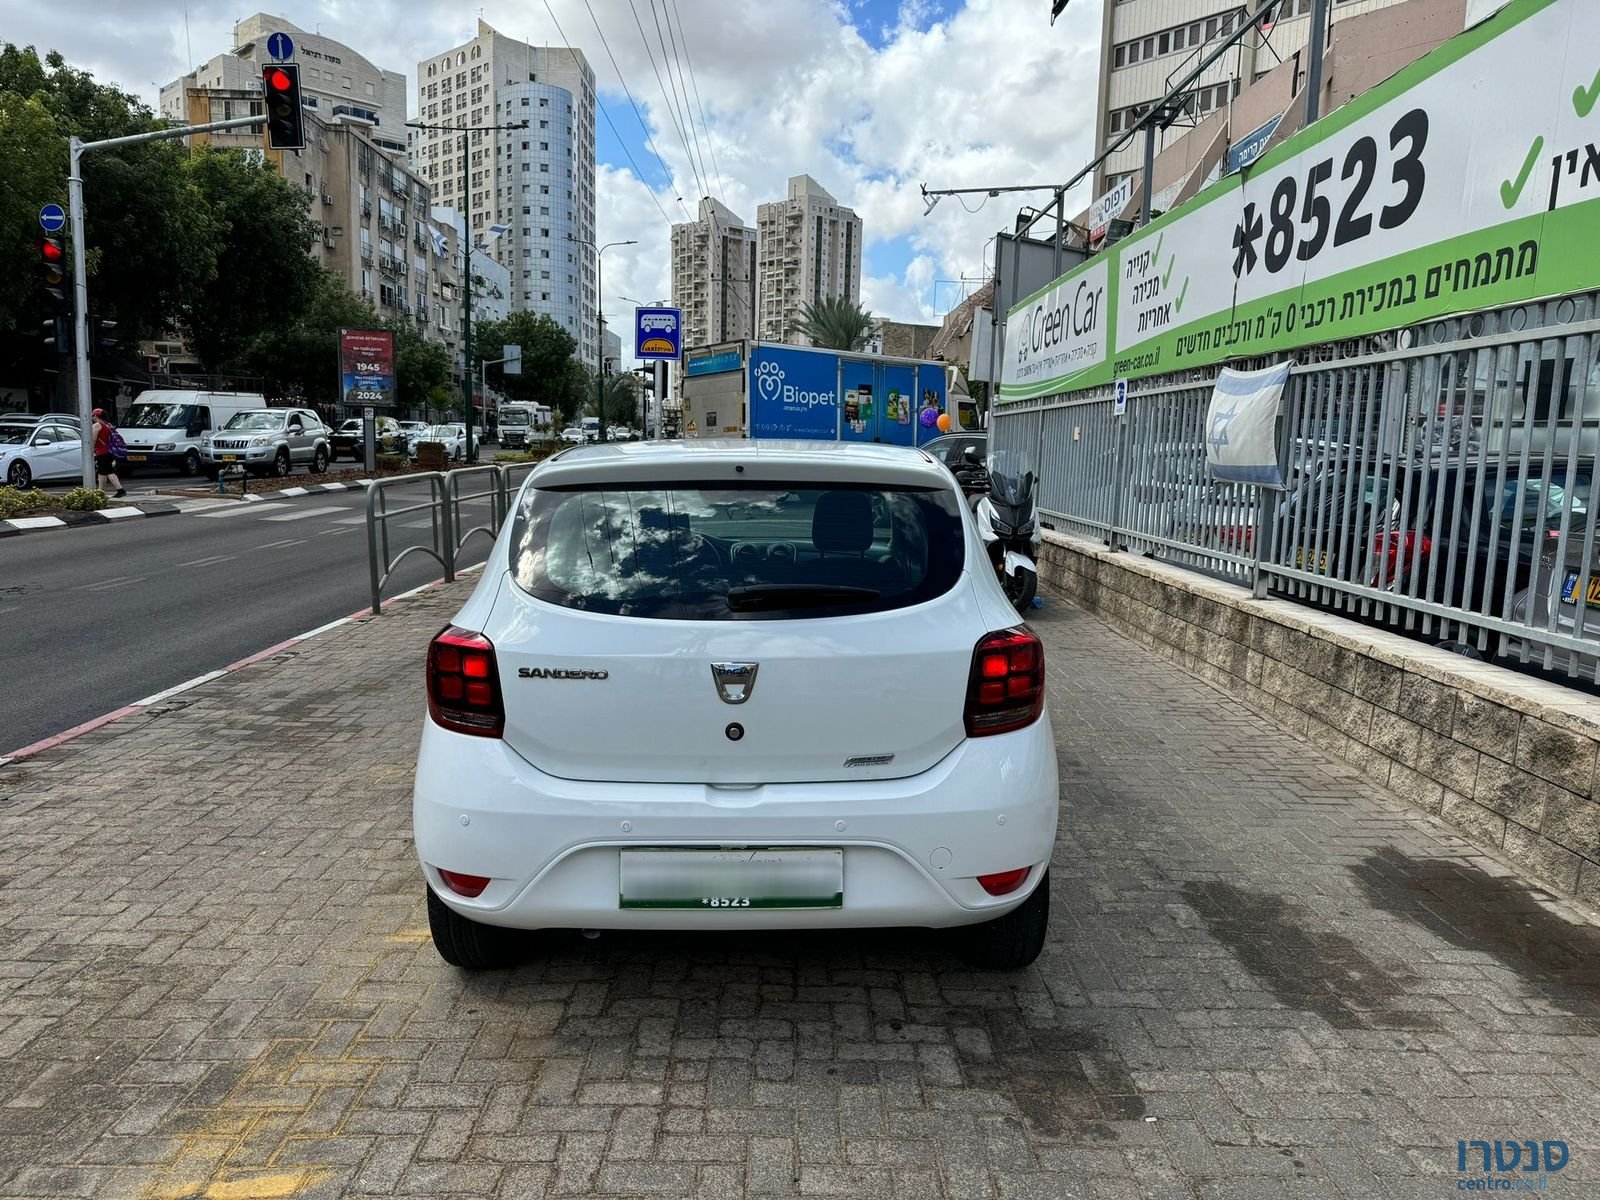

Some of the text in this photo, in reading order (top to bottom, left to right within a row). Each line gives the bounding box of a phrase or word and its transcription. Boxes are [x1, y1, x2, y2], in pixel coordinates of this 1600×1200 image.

[1104, 184, 1126, 213] דפוס
[1126, 250, 1150, 279] קנייה
[1424, 239, 1538, 300] מתמחים
[1132, 276, 1159, 305] מכירה
[1339, 274, 1416, 320] במכירת
[1032, 280, 1103, 353] Green Car
[1138, 302, 1171, 333] אחריות
[1301, 297, 1336, 329] רכבי
[1176, 330, 1211, 357] חדשים
[1213, 318, 1252, 347] ורכבים
[356, 363, 380, 371] 1945
[1113, 346, 1160, 378] green-car.co.il
[356, 392, 382, 400] 2024
[783, 385, 835, 408] Biopet
[518, 667, 609, 680] SANDERO
[720, 667, 750, 675] DACIA
